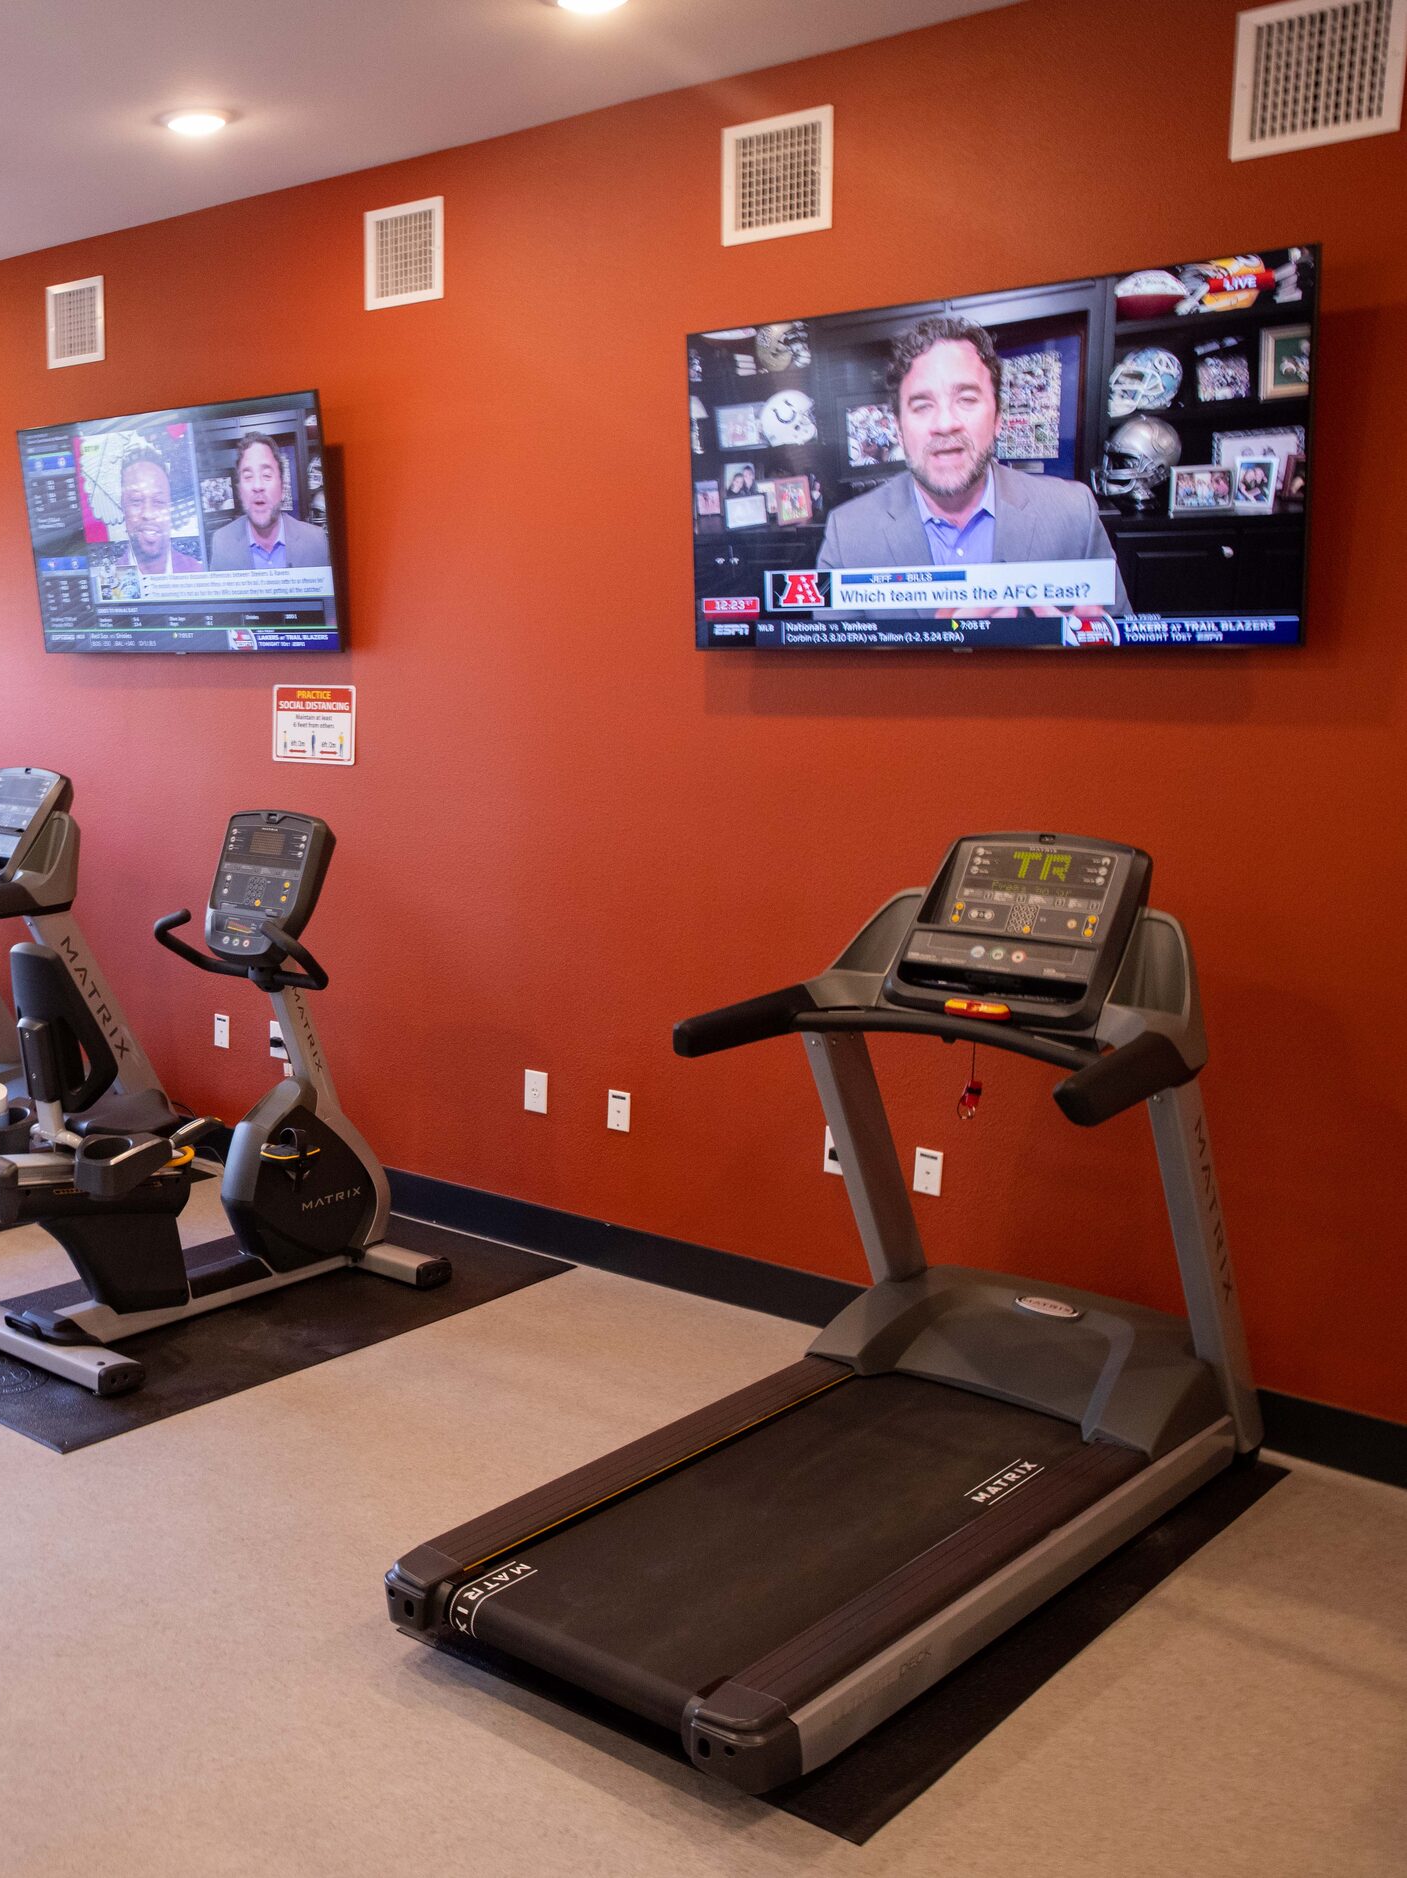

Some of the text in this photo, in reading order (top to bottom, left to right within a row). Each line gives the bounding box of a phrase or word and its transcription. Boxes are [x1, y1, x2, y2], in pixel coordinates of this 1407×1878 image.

[1223, 275, 1257, 291] LIVE
[870, 572, 933, 584] JEFF BILLS
[841, 582, 1091, 604] Which team wins the AFC East?
[715, 600, 745, 610] 12:23
[713, 624, 749, 636] ESPN
[757, 623, 774, 632] MLB
[786, 622, 878, 632] Nationals vs Yankees
[978, 620, 991, 630] ET
[1090, 621, 1108, 632] NBA
[1124, 620, 1276, 632] LAKERS AT TRAIL BLAZERS
[787, 633, 812, 642] Corbin
[847, 633, 868, 643] ERA)
[868, 634, 878, 642] vs
[942, 631, 965, 643] ERA)
[1077, 632, 1112, 643] ESPN
[1124, 633, 1169, 642] TONIGHT
[1195, 632, 1224, 642] ESPN
[296, 690, 331, 700] PRACTICE
[279, 700, 350, 711] SOCIAL DISTANCING
[1013, 851, 1072, 882] TR
[61, 936, 130, 1061] MATRIX
[301, 1185, 362, 1212] MATRIX
[971, 1461, 1038, 1504] MATRIX
[455, 1563, 532, 1636] MATRIX
